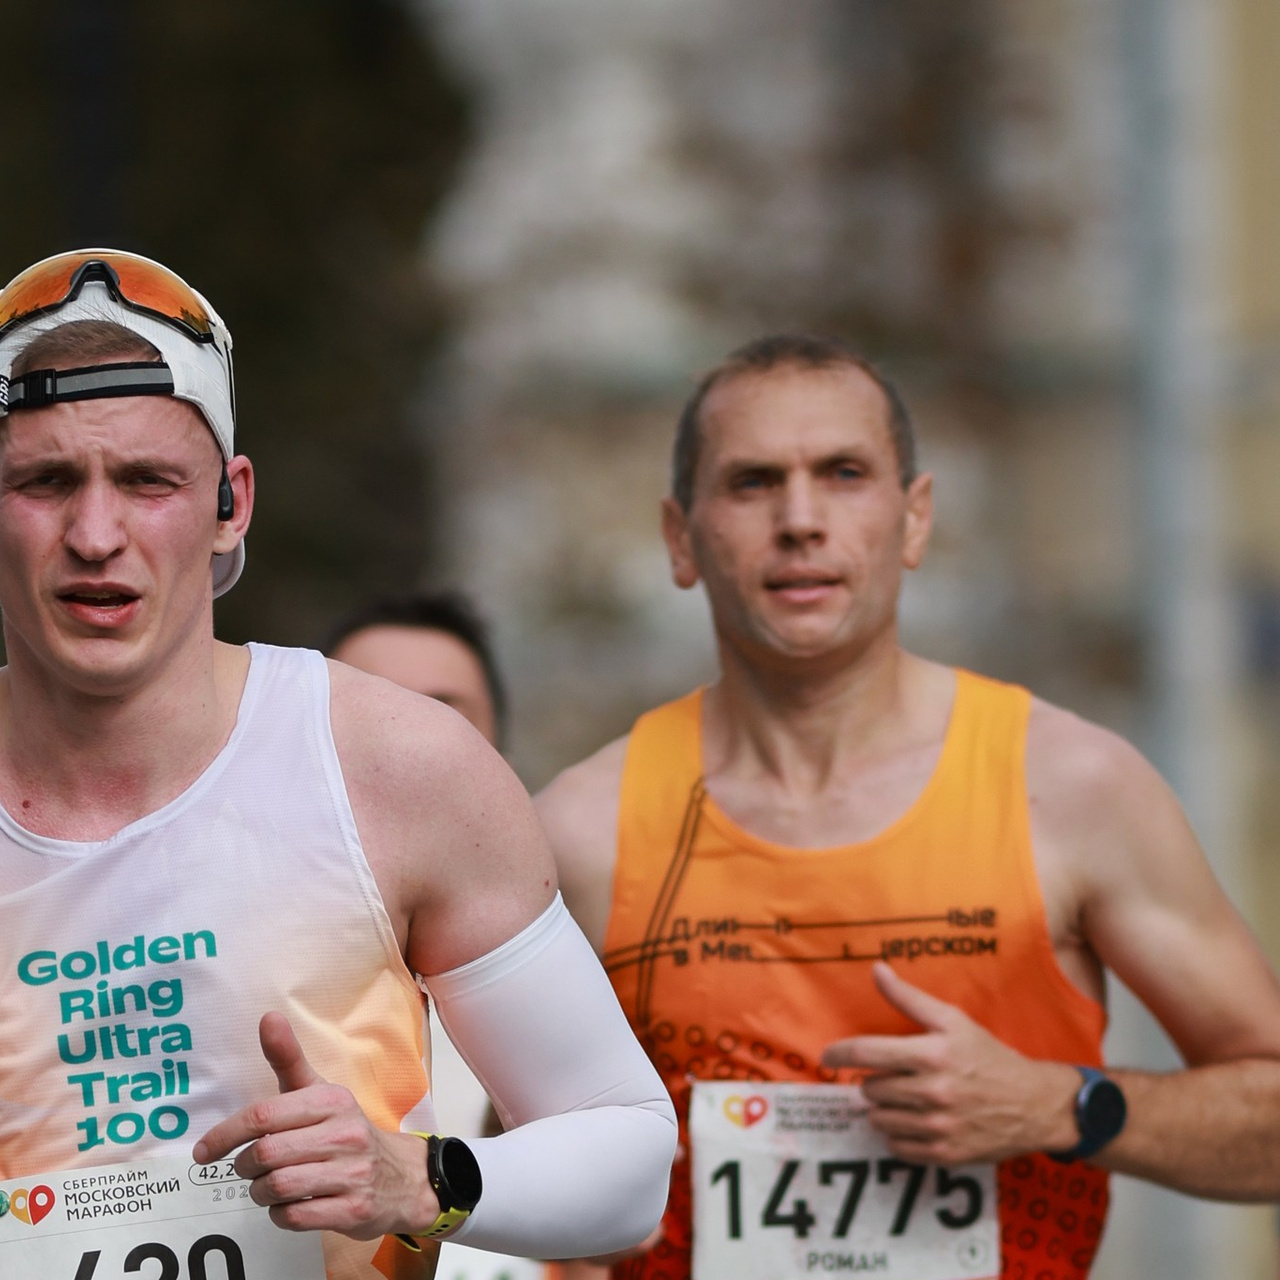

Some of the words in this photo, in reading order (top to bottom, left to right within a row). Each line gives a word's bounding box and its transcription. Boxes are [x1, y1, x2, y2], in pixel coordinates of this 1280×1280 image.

[17, 929, 217, 986] Golden
[59, 978, 184, 1024] Ring
[57, 1022, 193, 1065] Ultra
[67, 1058, 190, 1107] Trail
[76, 1105, 190, 1152] 100
[62, 1170, 149, 1192] СБЕРПРАЙМ
[64, 1177, 181, 1207] МОСКОВСКИЙ
[710, 1158, 984, 1241] 14775
[66, 1198, 153, 1222] МАРАФОН
